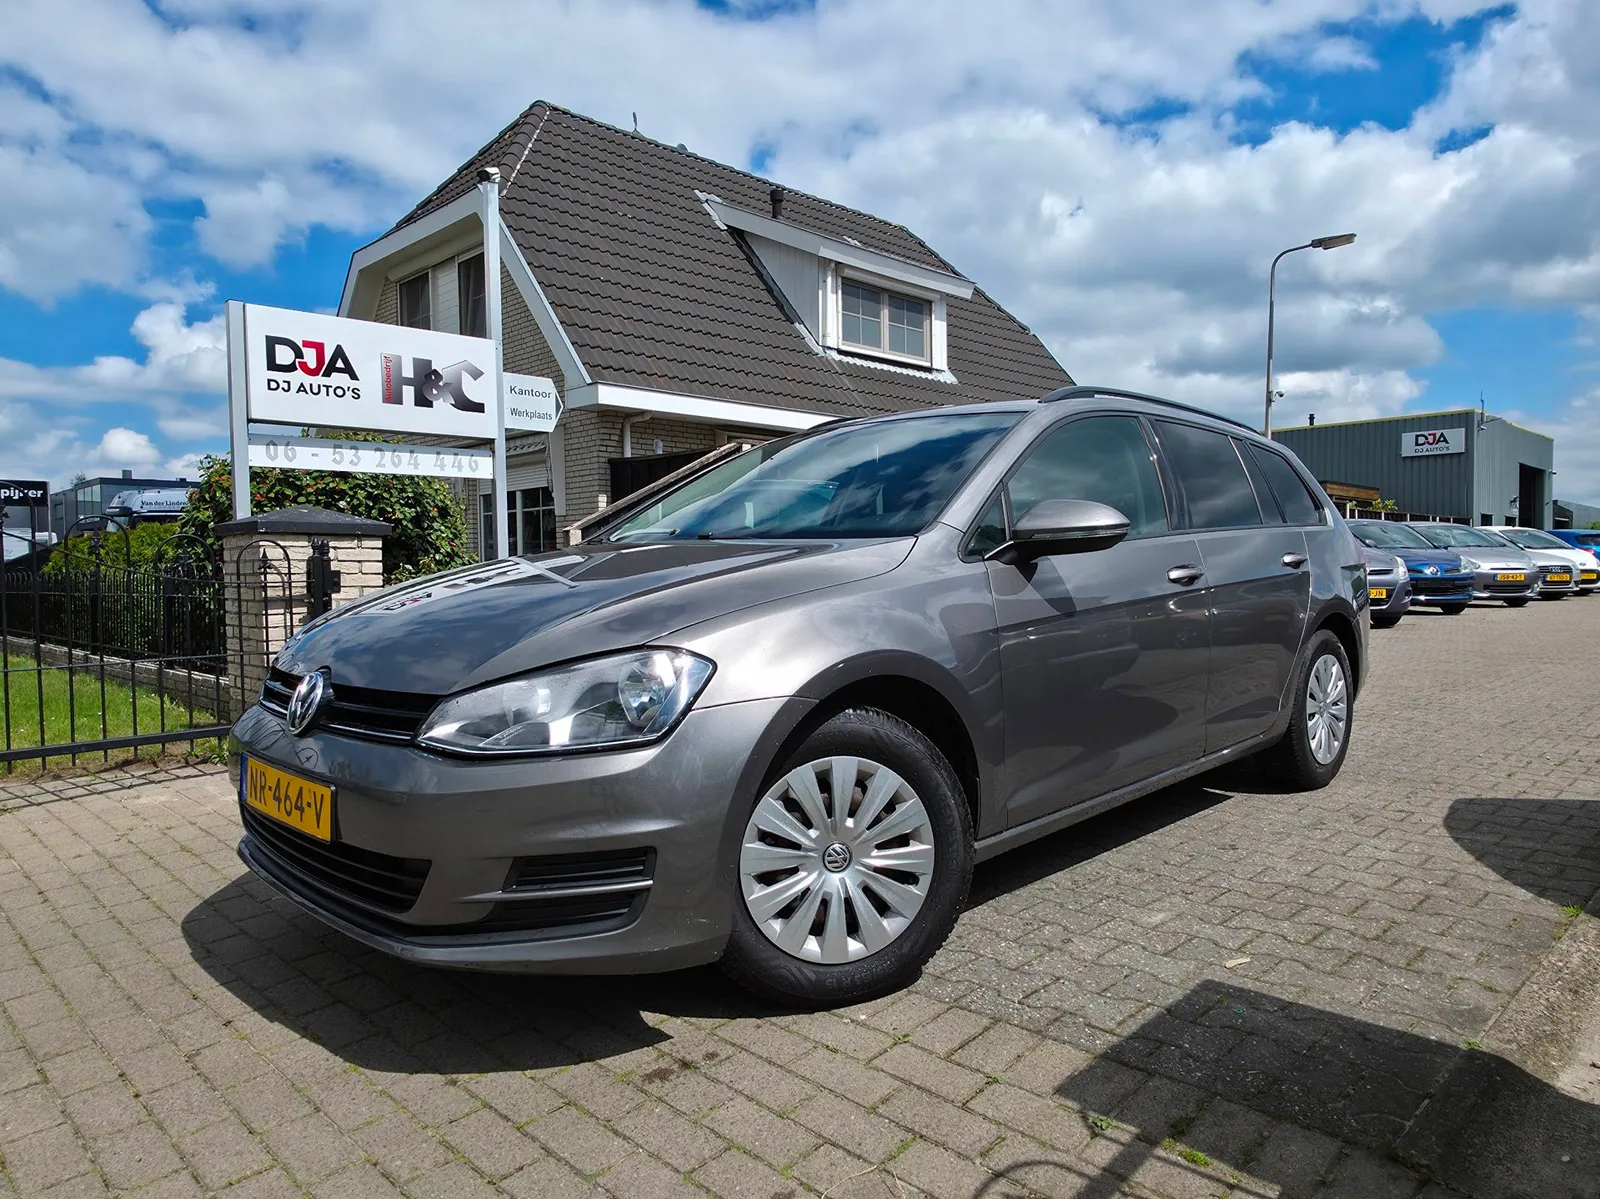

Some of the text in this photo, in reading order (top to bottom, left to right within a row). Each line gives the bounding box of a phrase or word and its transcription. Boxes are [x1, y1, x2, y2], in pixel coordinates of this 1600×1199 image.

[265, 335, 360, 381] DJA
[267, 379, 361, 400] DJ AUTO'S
[509, 385, 553, 400] Kantoor
[509, 407, 553, 421] Werkplaats
[1414, 432, 1450, 446] DJA
[265, 439, 297, 463] 06
[332, 443, 362, 467] 53
[374, 447, 421, 471] 264
[433, 450, 480, 473] 446
[249, 764, 324, 829] NR-464-V
